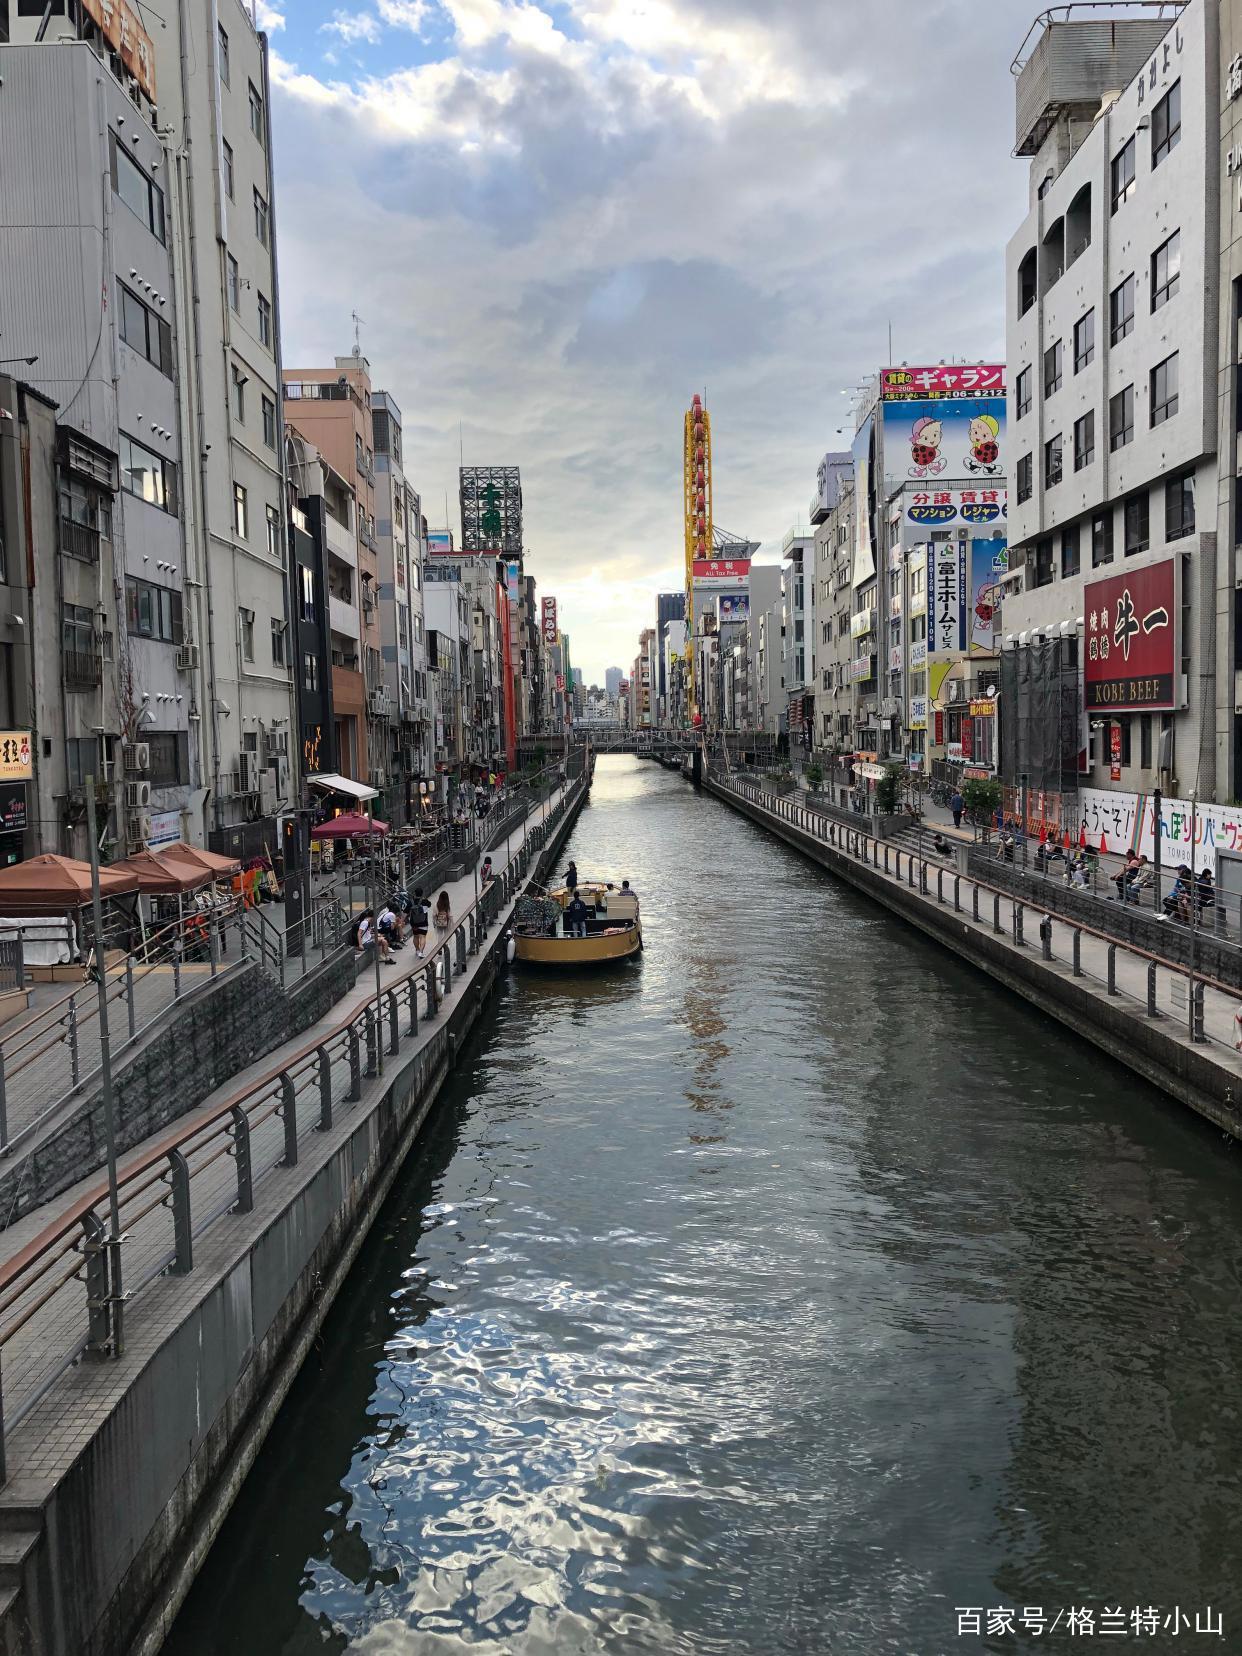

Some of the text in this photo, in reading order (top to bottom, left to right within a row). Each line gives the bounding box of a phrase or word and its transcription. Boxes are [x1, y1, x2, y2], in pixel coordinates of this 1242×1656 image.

[912, 490, 999, 505] 分譲 賃貸
[910, 506, 999, 518] マンション レジャー
[937, 561, 957, 649] 富士ホームサービス
[1089, 606, 1109, 632] 焼肉
[1113, 588, 1169, 662] 牛一
[1095, 679, 1160, 703] KOBE BEEF
